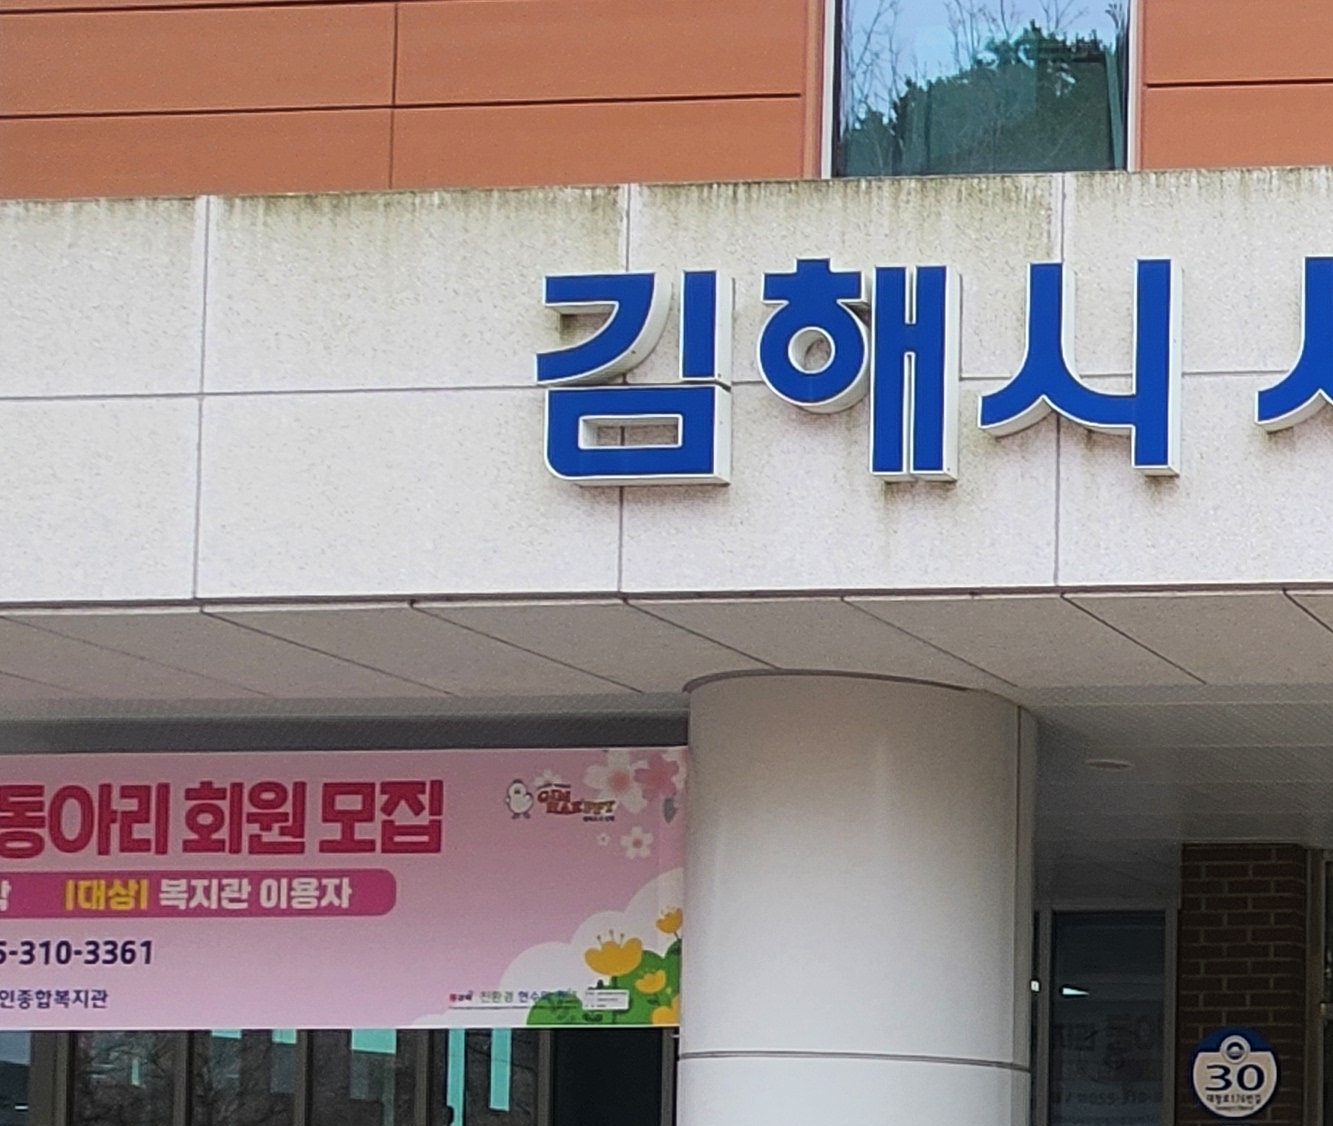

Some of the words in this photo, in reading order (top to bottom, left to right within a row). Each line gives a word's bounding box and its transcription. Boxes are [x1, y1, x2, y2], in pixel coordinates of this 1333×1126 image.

[535, 256, 1176, 485] 김해시
[0, 782, 170, 859] 동아리
[182, 781, 307, 855] 회원
[318, 780, 444, 854] 모집
[159, 878, 251, 910] 복지관
[259, 877, 352, 909] 이용자
[1205, 1064, 1265, 1091] 30
